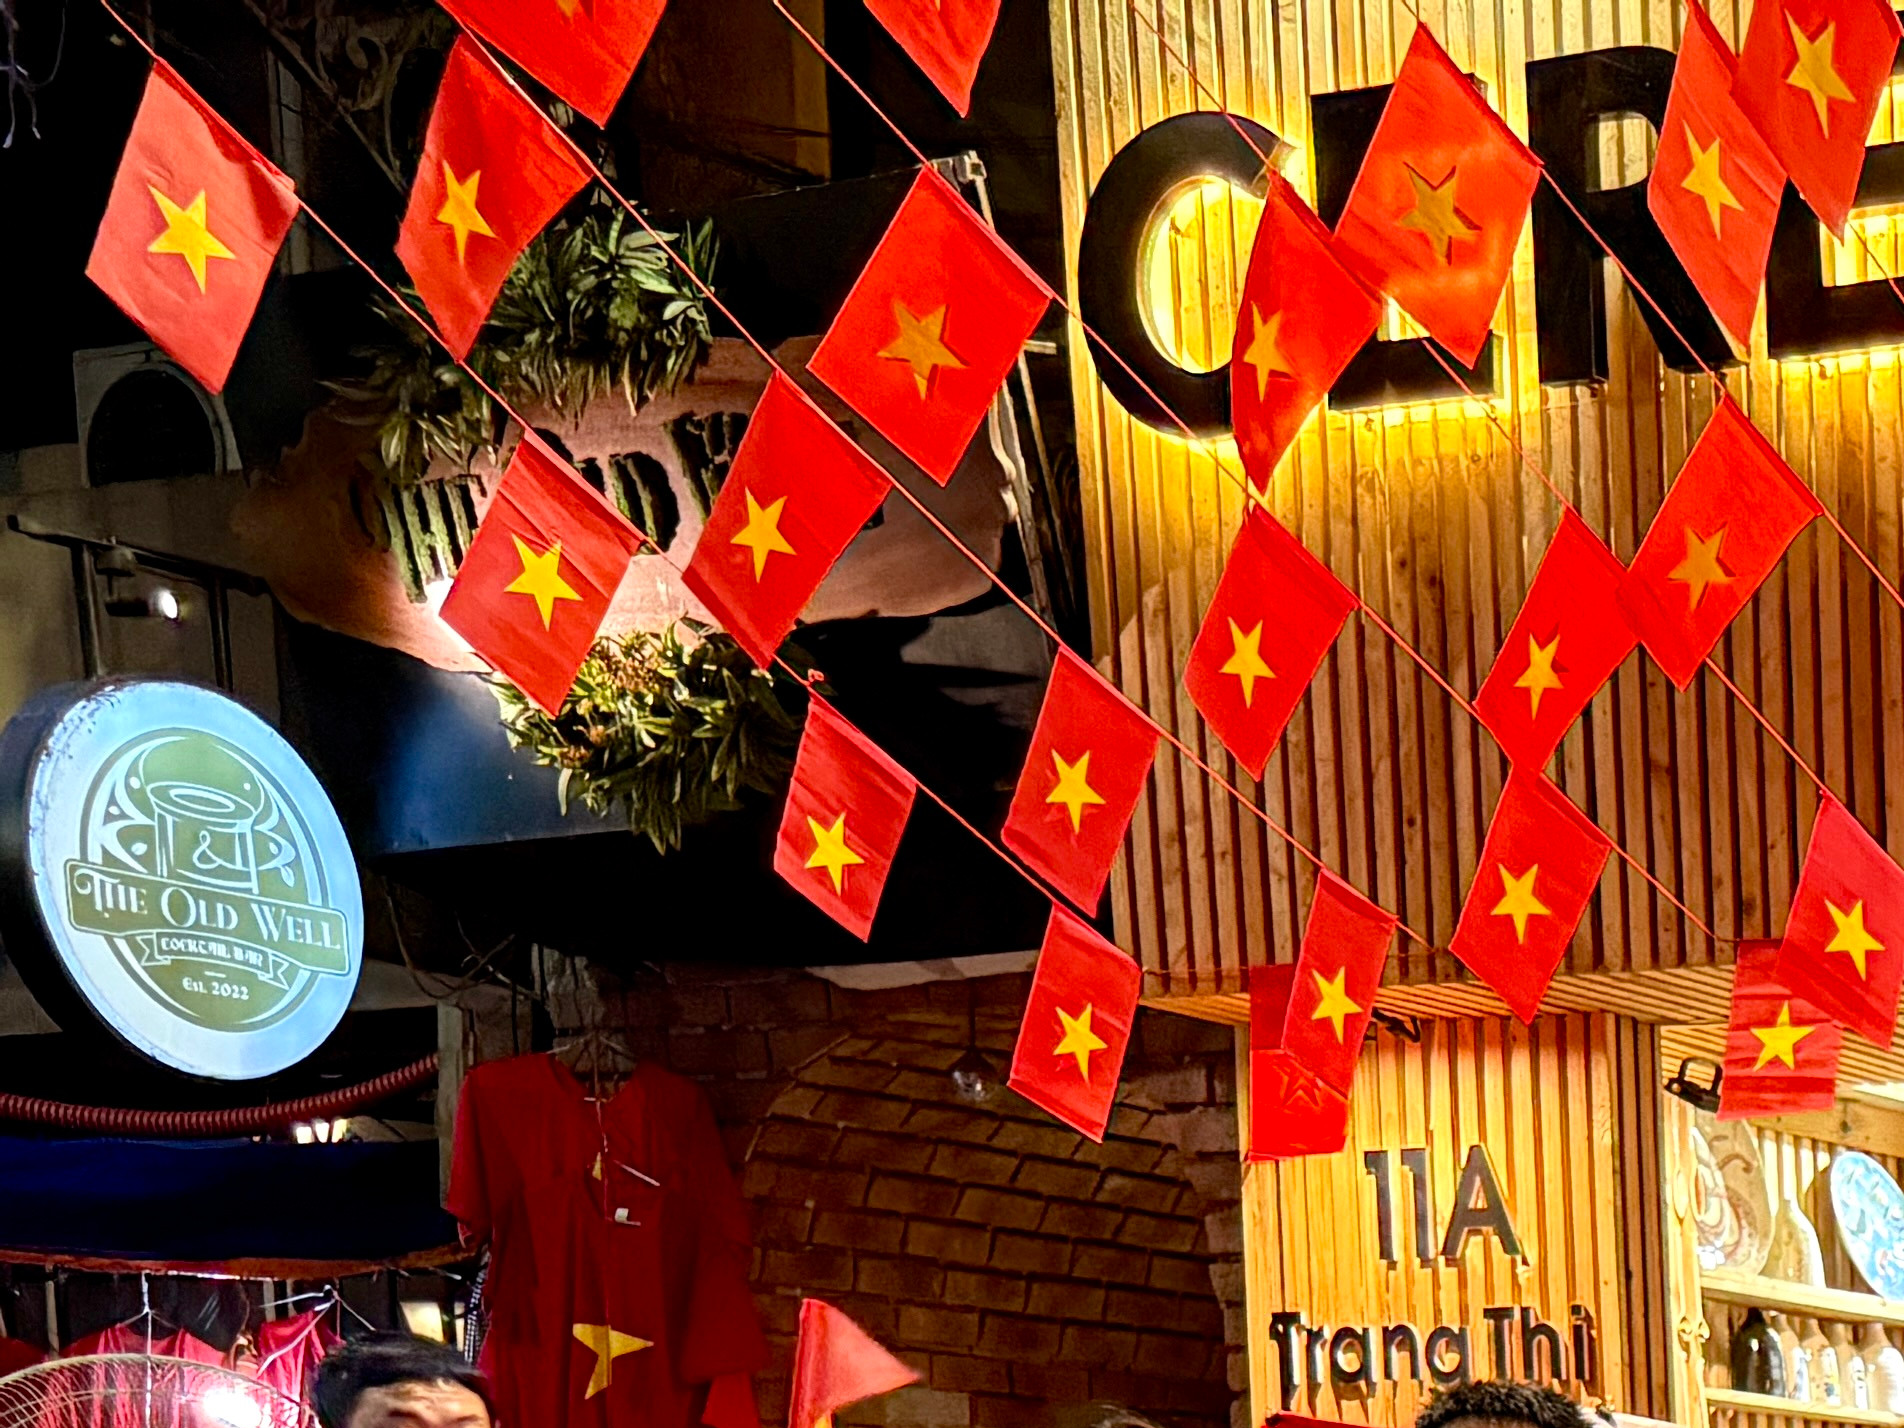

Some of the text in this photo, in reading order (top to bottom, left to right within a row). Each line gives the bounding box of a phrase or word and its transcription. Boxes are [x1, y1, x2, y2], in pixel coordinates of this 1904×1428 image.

[160, 937, 263, 967] COCKTAIL BAR
[211, 982, 249, 1000] 2022
[1364, 1144, 1522, 1262] 11A
